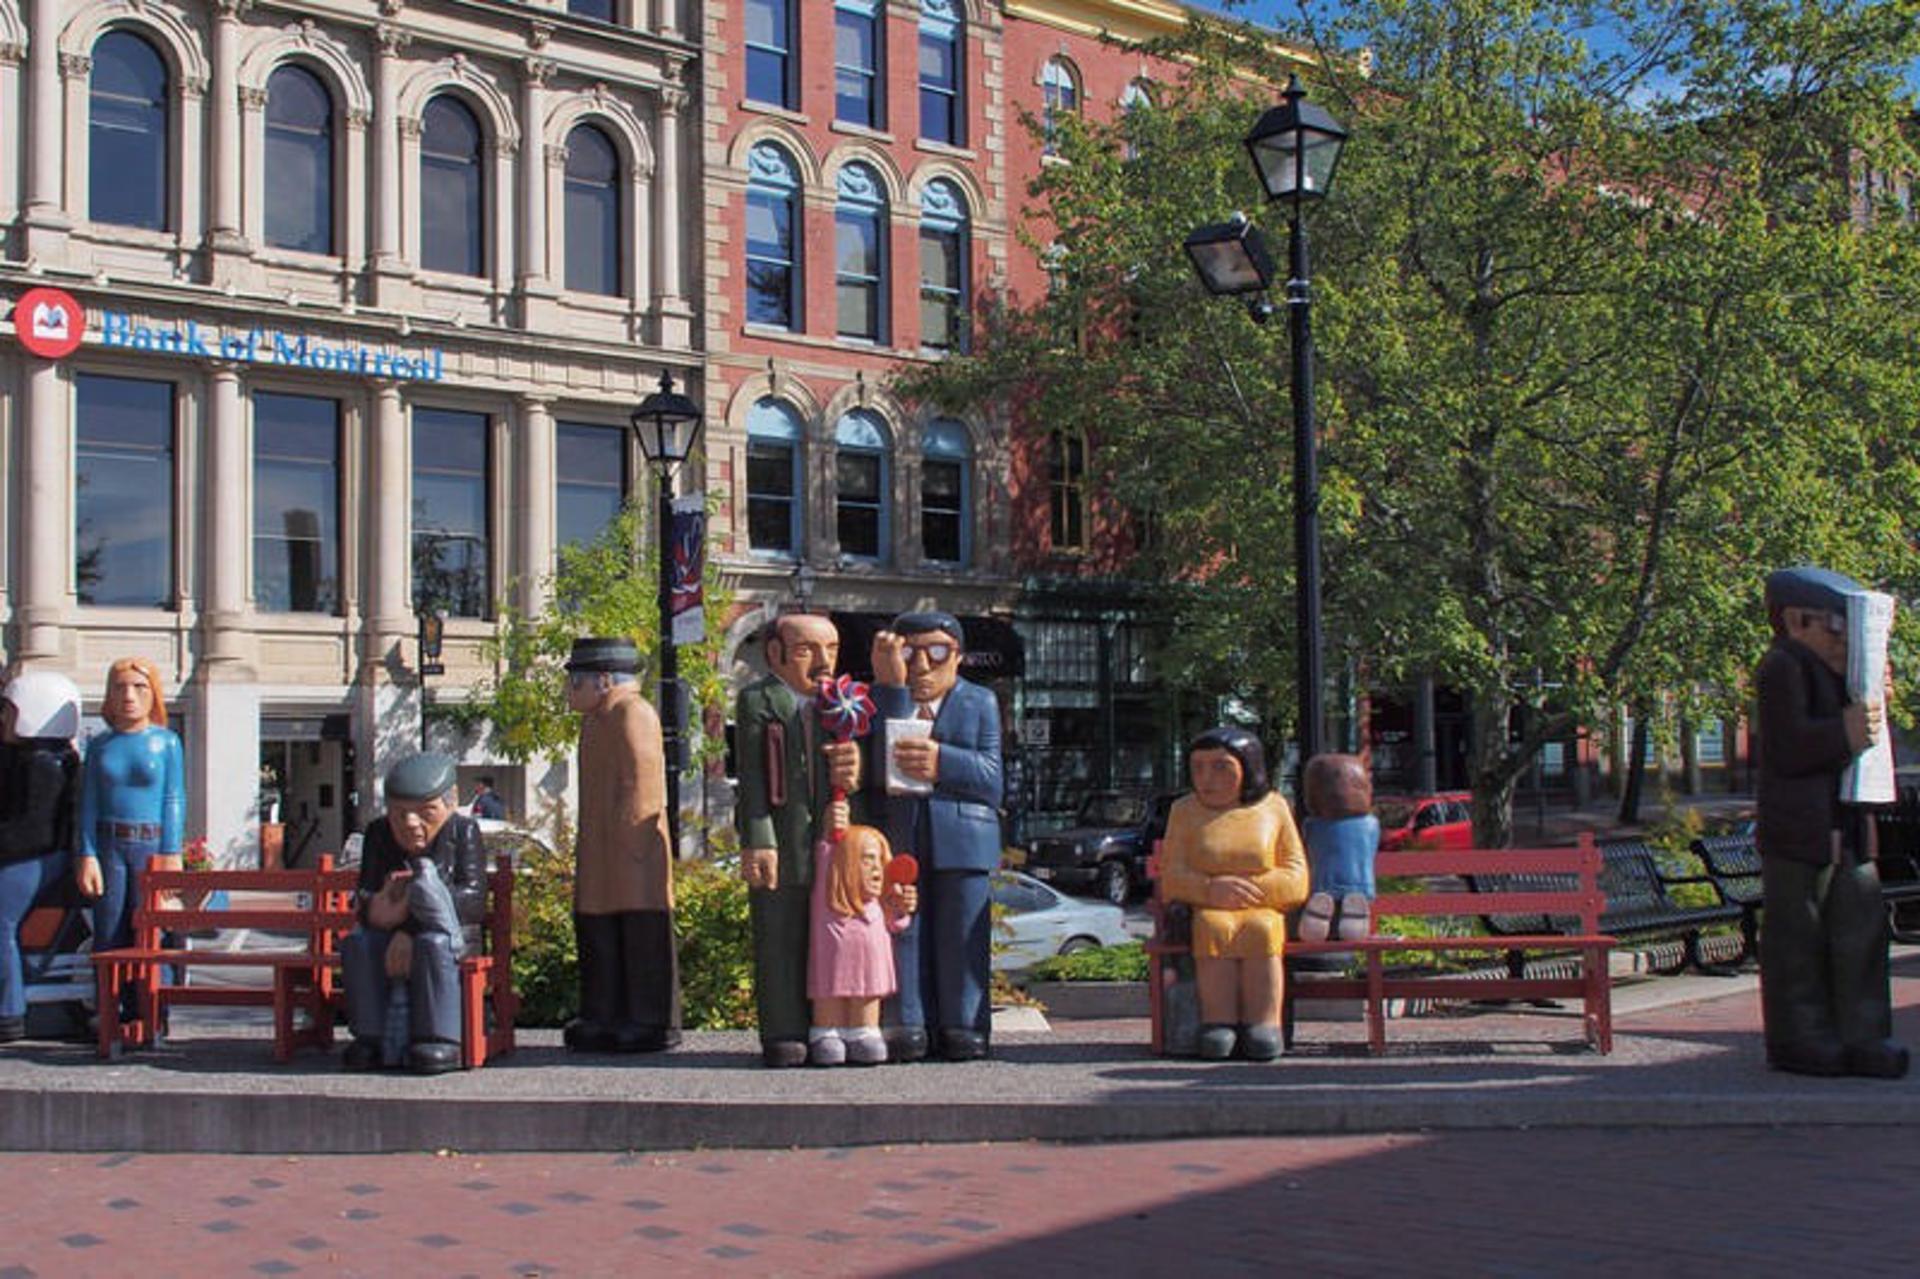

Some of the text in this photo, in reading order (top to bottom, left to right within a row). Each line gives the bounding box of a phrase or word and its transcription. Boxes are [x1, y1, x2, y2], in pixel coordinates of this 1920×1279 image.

[102, 310, 443, 381] Bank of Montreal
